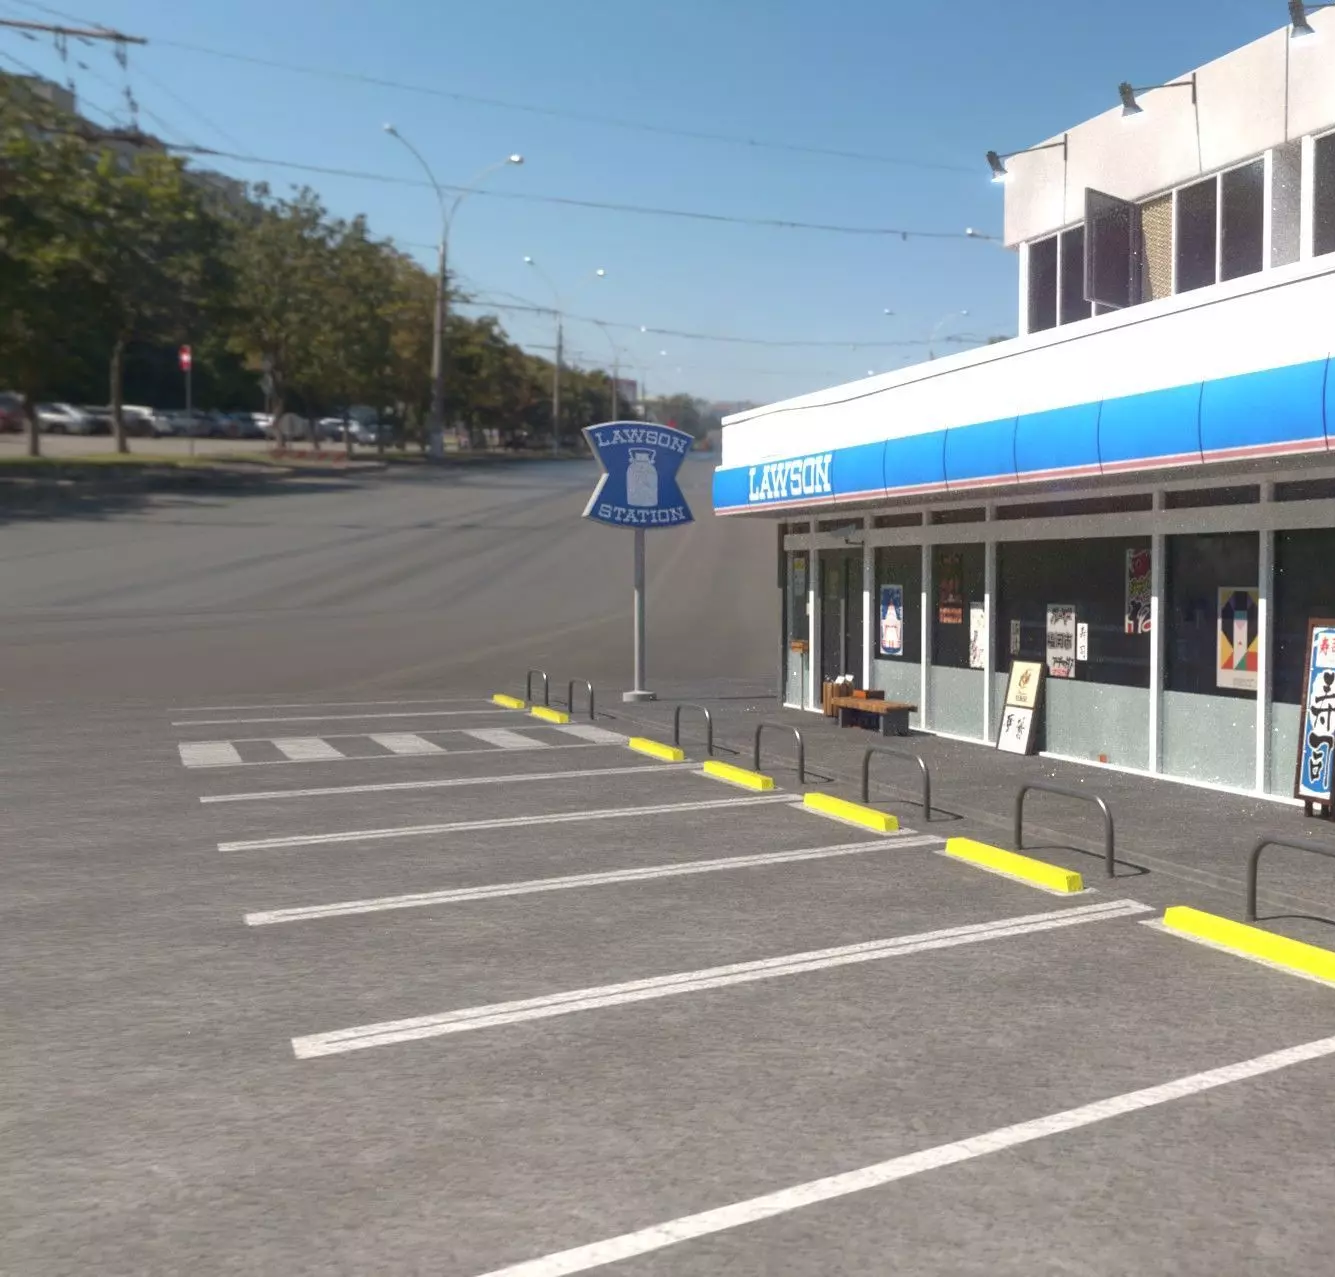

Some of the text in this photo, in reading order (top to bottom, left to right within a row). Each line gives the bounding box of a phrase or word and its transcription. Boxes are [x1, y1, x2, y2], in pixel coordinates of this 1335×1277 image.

[596, 430, 688, 452] LAWSON
[749, 454, 833, 501] LAWSON
[599, 503, 686, 524] STATION
